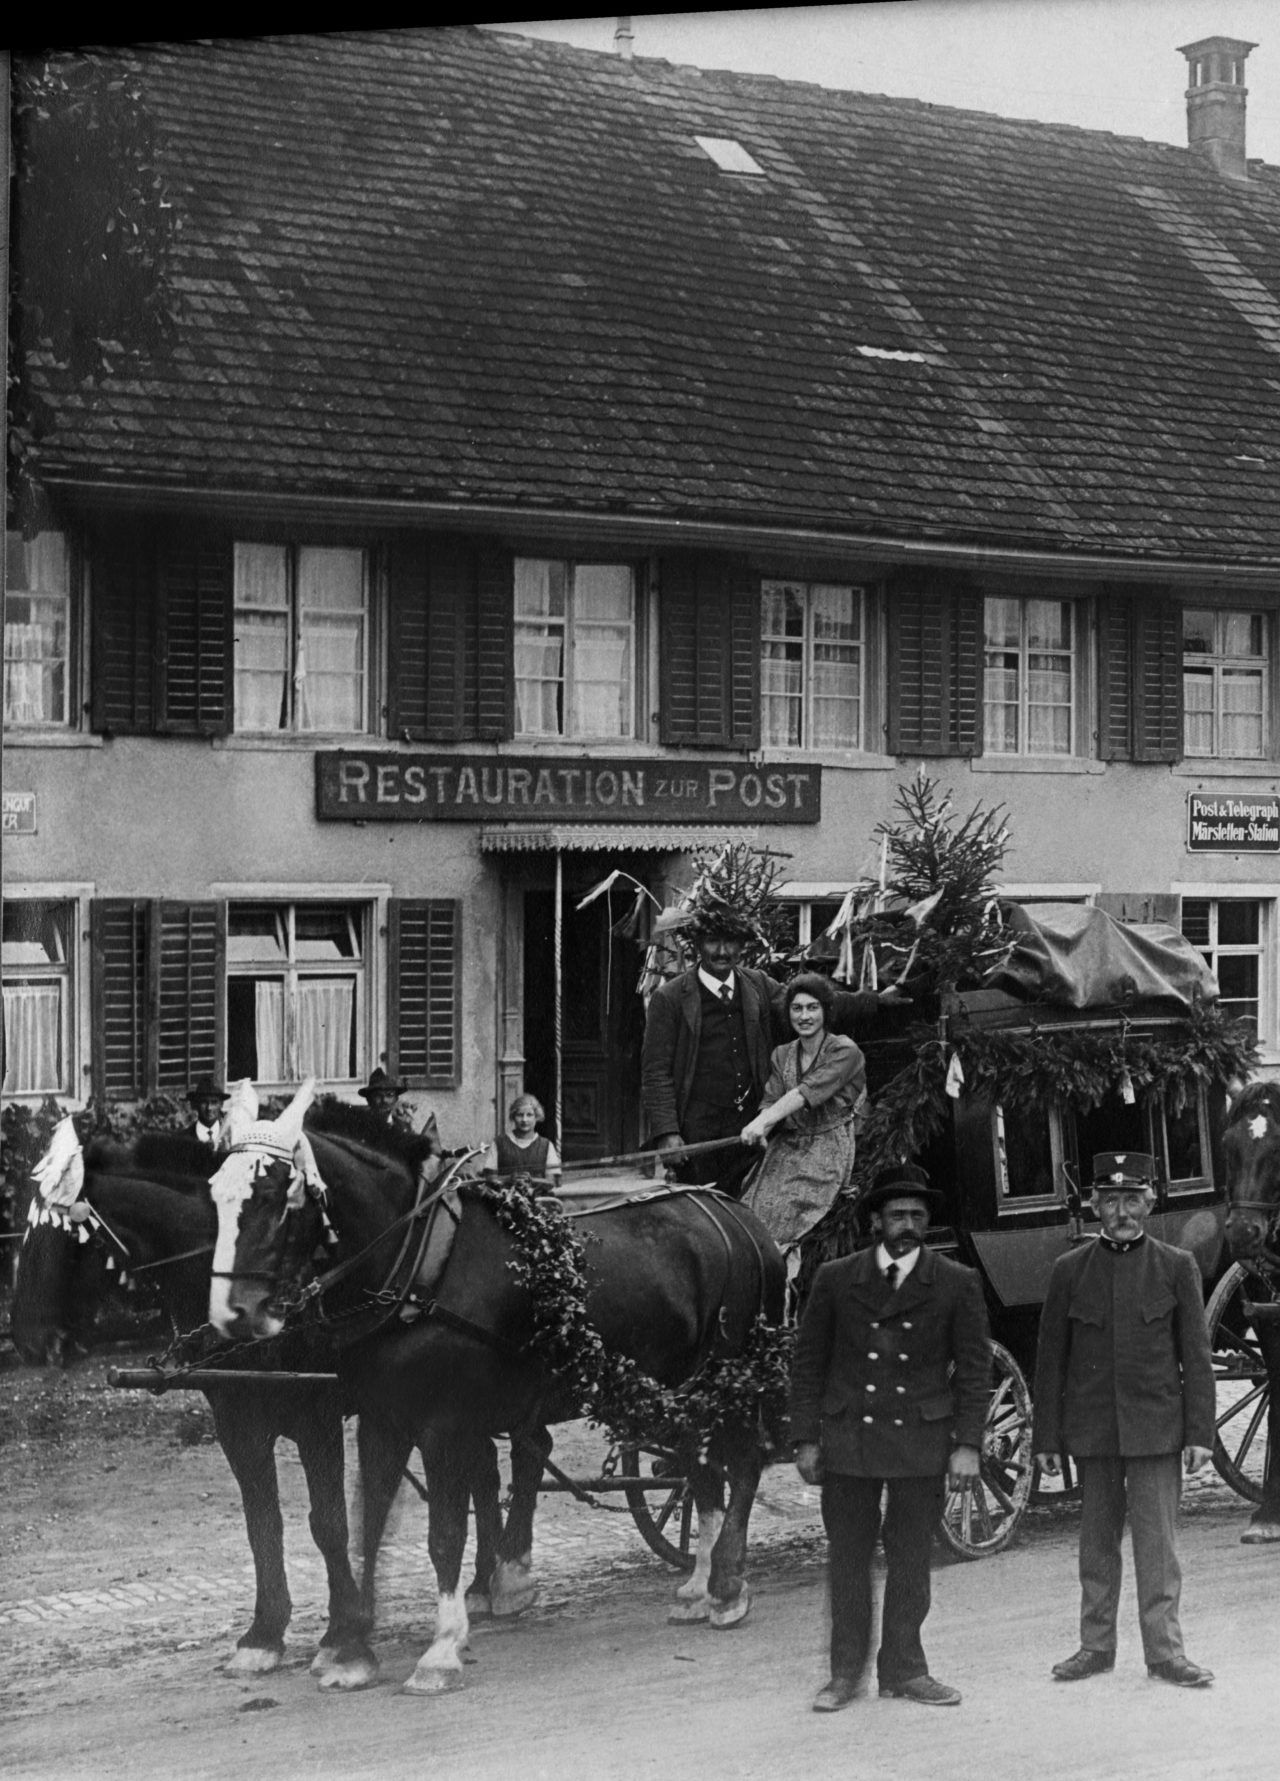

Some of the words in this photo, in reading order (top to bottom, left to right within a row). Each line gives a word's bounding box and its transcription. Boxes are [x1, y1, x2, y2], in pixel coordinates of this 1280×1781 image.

[338, 759, 645, 807] RESTAURATION
[654, 779, 699, 798] ZUR
[706, 768, 810, 809] POST
